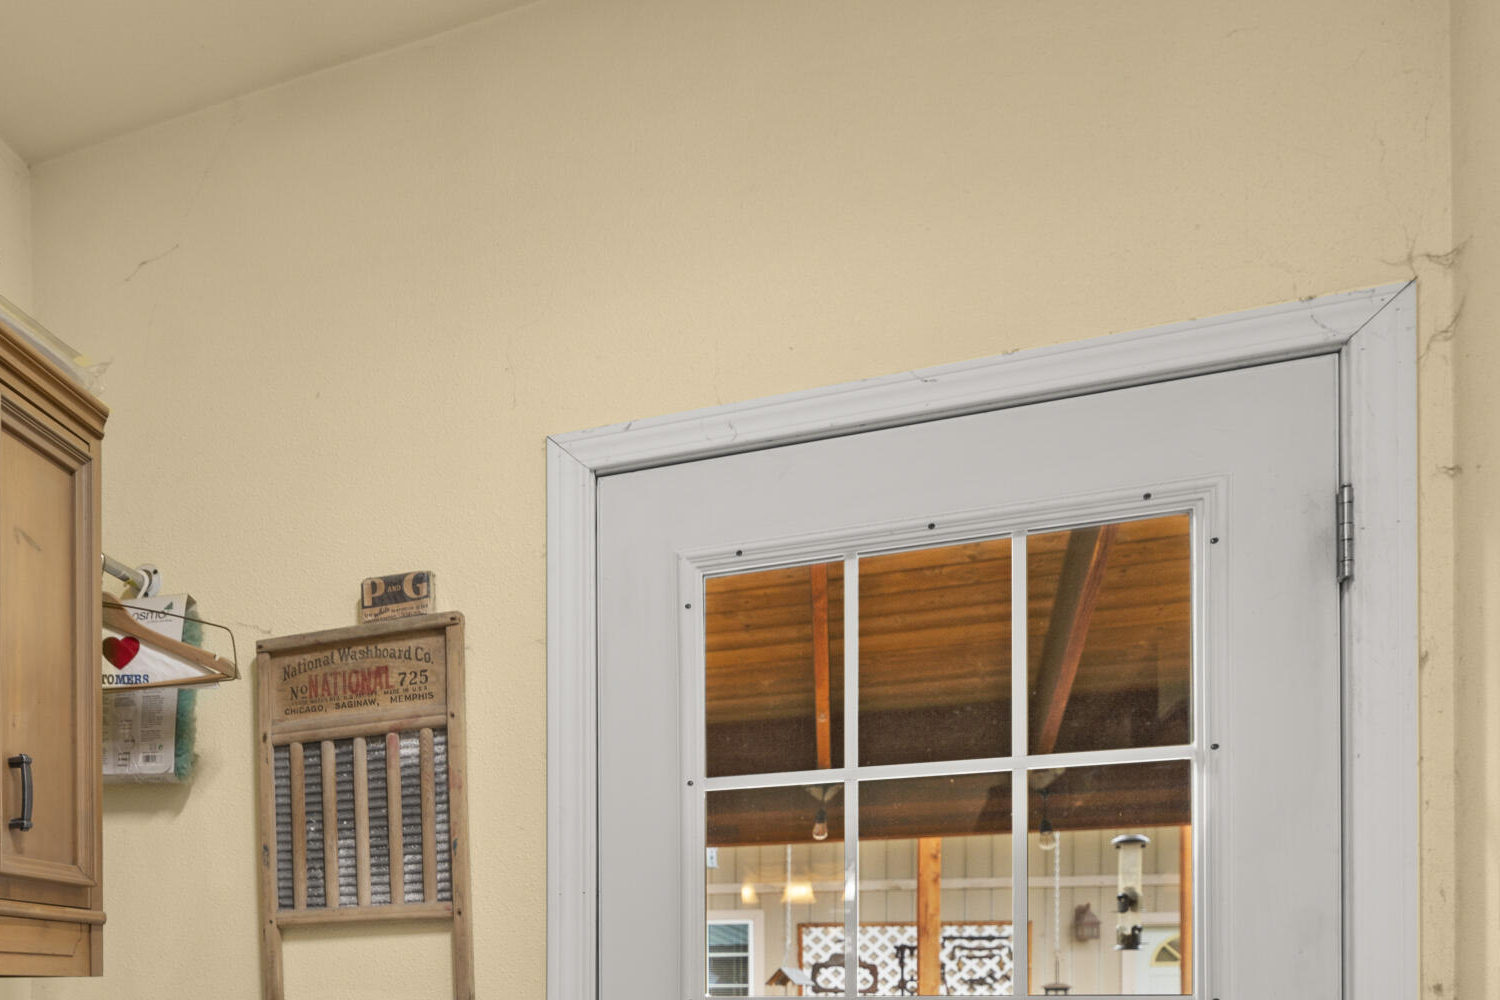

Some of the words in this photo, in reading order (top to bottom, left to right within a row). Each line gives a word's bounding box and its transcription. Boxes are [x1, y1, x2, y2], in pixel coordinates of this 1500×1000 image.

[363, 578, 385, 606] P
[403, 571, 428, 599] G
[282, 651, 335, 682] National
[336, 645, 412, 663] Washboard
[414, 646, 434, 665] Co.
[398, 669, 429, 687] 725
[308, 665, 395, 699] NATIONAL
[284, 704, 328, 716] CHICAGO,
[334, 700, 380, 710] SAGINAW,
[390, 691, 435, 704] MEMPHIS
